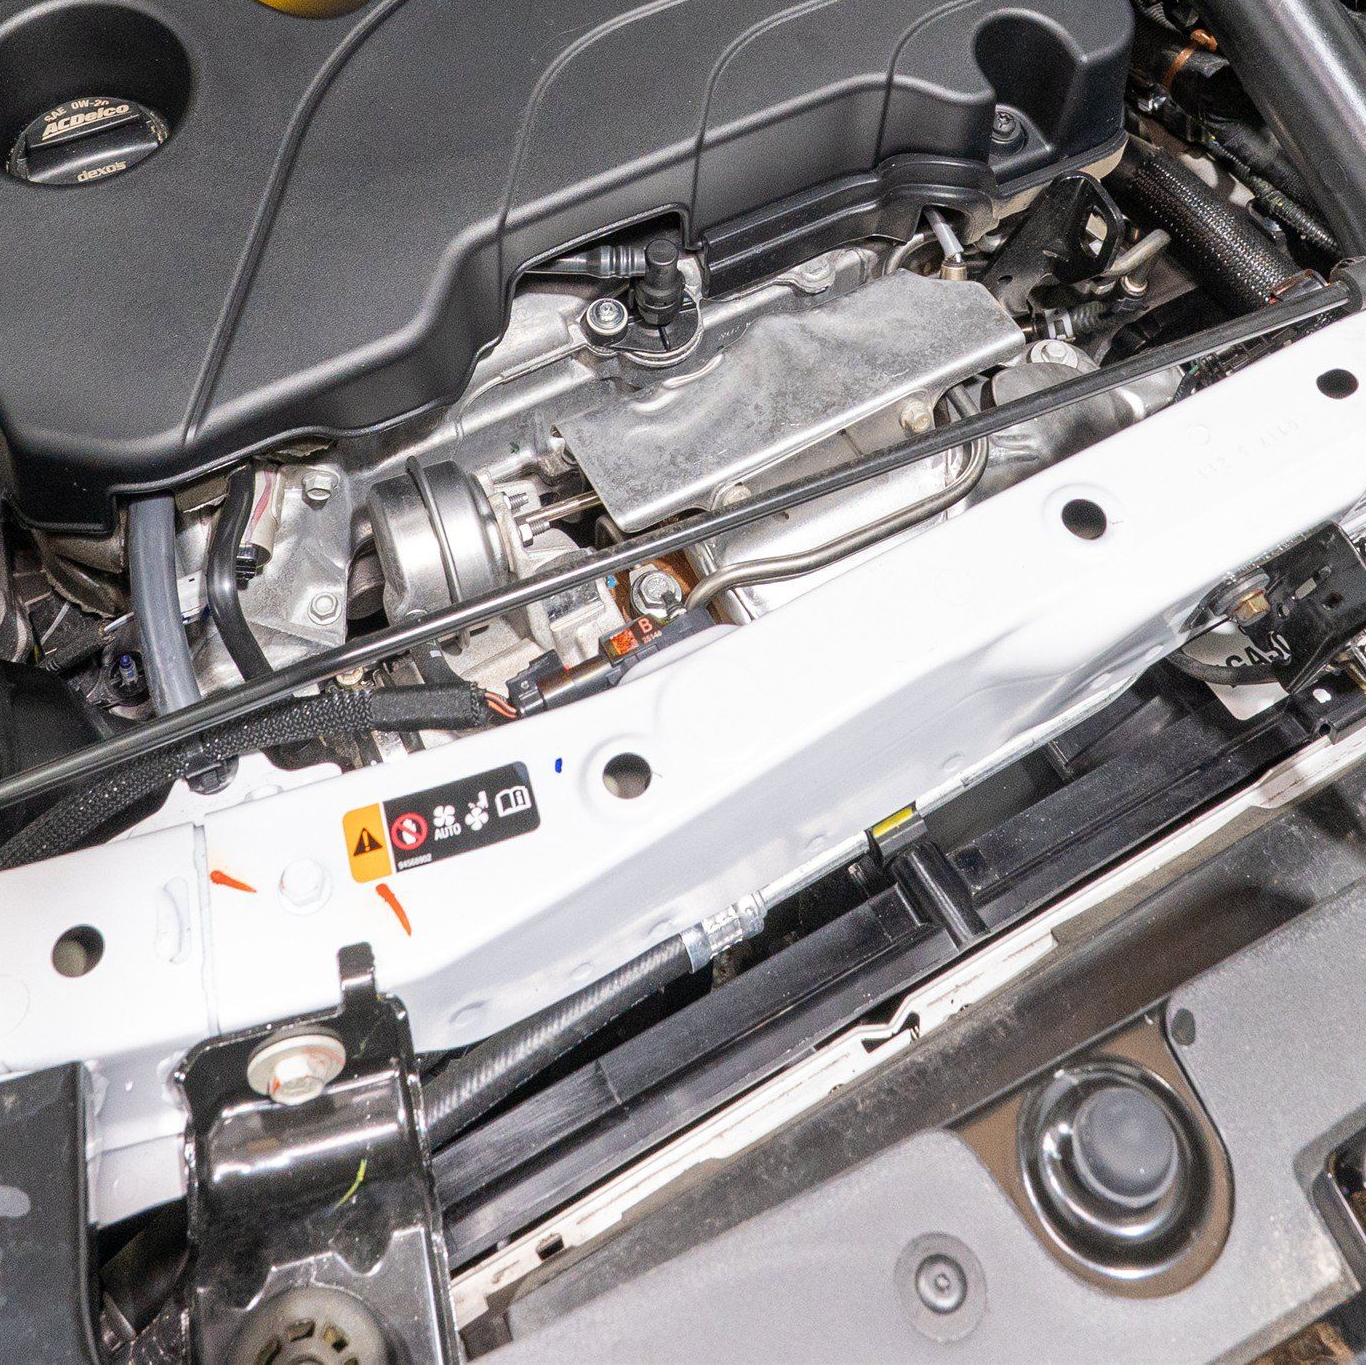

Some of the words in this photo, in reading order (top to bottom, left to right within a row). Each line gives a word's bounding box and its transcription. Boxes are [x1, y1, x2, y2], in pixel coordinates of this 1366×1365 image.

[42, 104, 130, 138] ACDelco
[43, 106, 67, 122] SAE
[638, 617, 653, 633] B
[434, 822, 462, 841] AUTO
